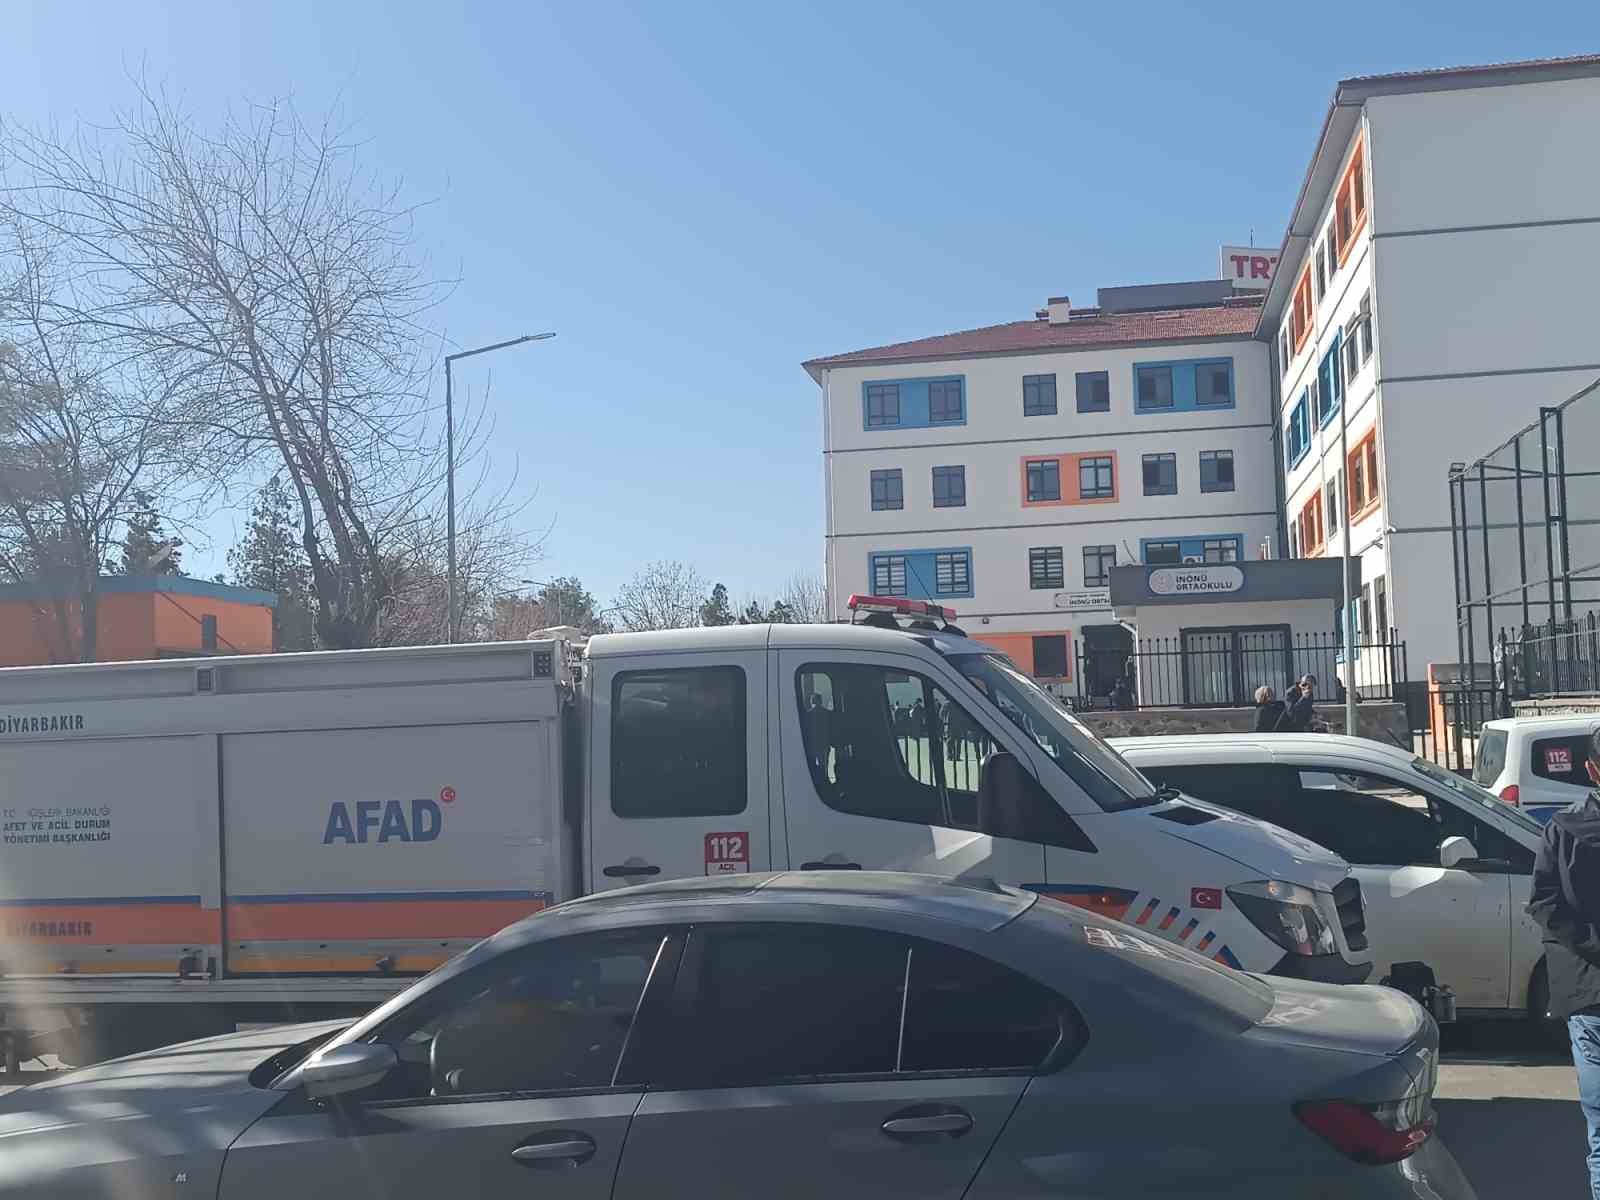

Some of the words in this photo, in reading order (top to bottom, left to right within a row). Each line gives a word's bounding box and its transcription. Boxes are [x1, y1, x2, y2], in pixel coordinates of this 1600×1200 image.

[1176, 582, 1233, 591] ORTAOKULU
[0, 714, 84, 733] DİYARBAKIR
[1549, 751, 1569, 763] 112
[31, 821, 44, 830] VE
[74, 819, 110, 829] DURUM
[322, 799, 442, 844] AFAD
[710, 837, 743, 859] 112
